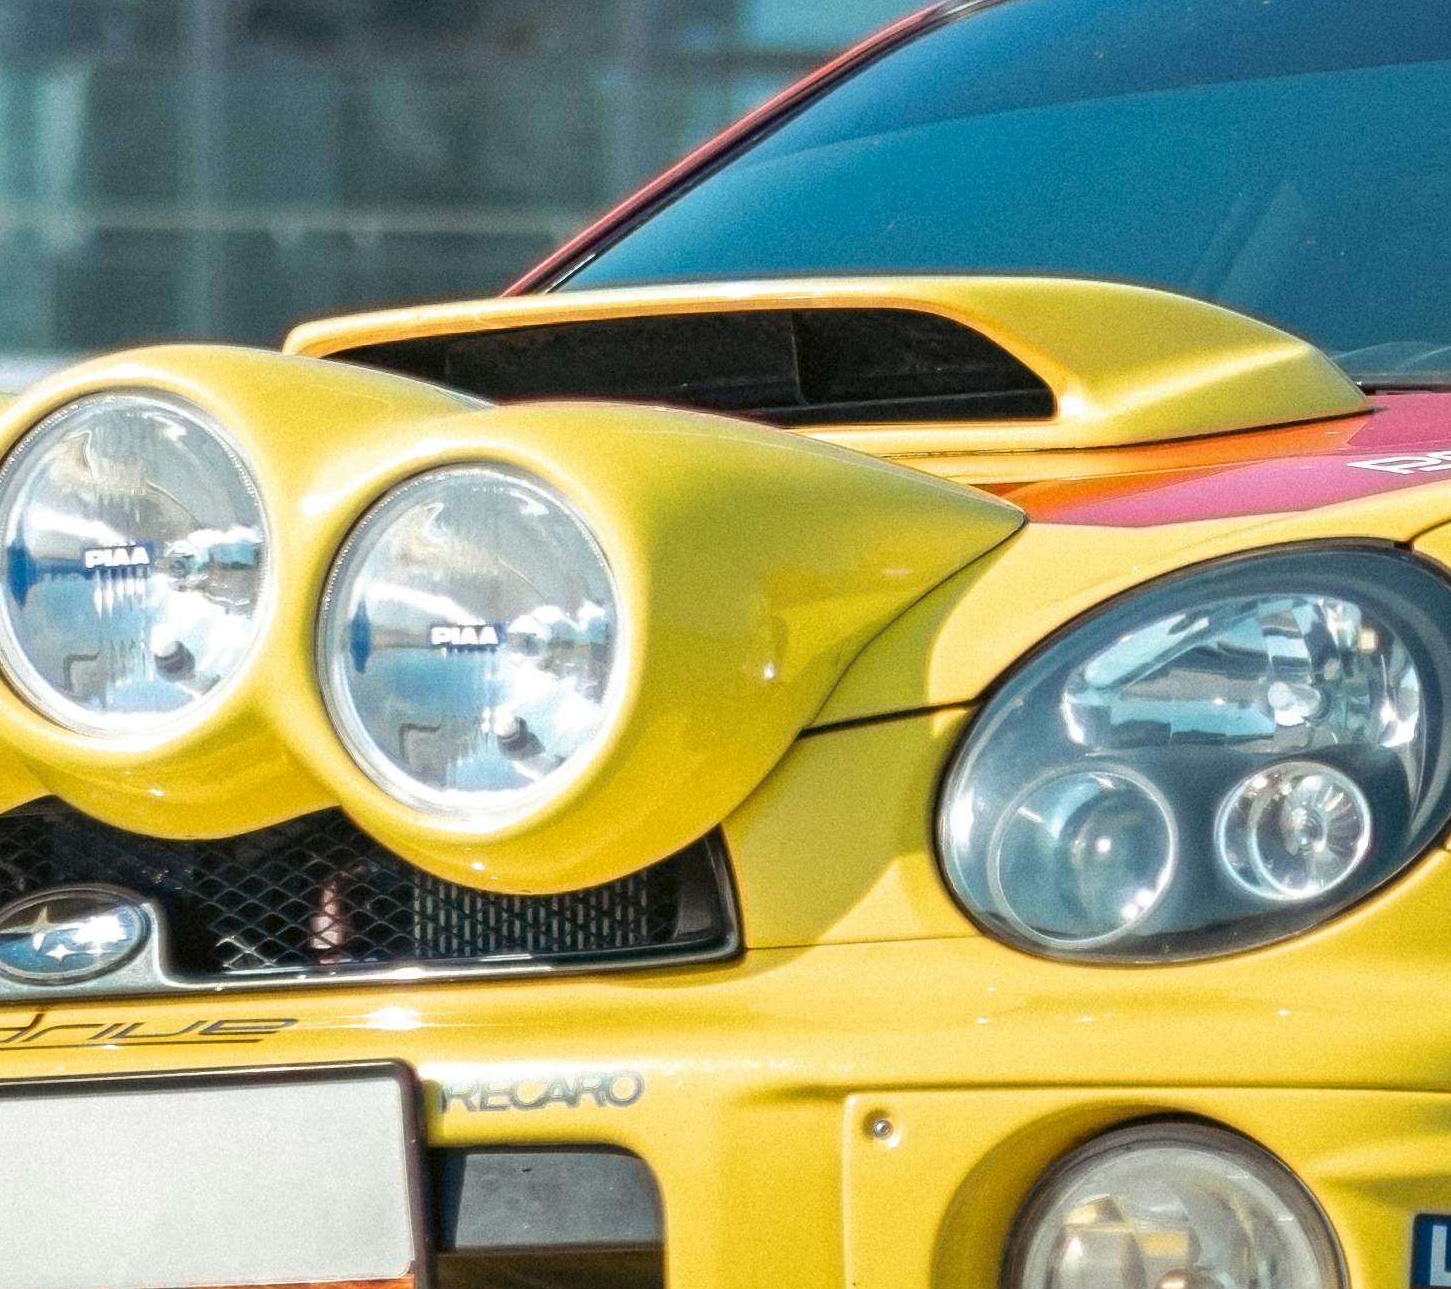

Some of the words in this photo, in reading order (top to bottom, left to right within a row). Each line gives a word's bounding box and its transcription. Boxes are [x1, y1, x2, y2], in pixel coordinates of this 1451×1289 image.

[85, 547, 149, 568] PIAA
[431, 625, 498, 645] PIAA
[440, 1069, 644, 1114] RECARO
